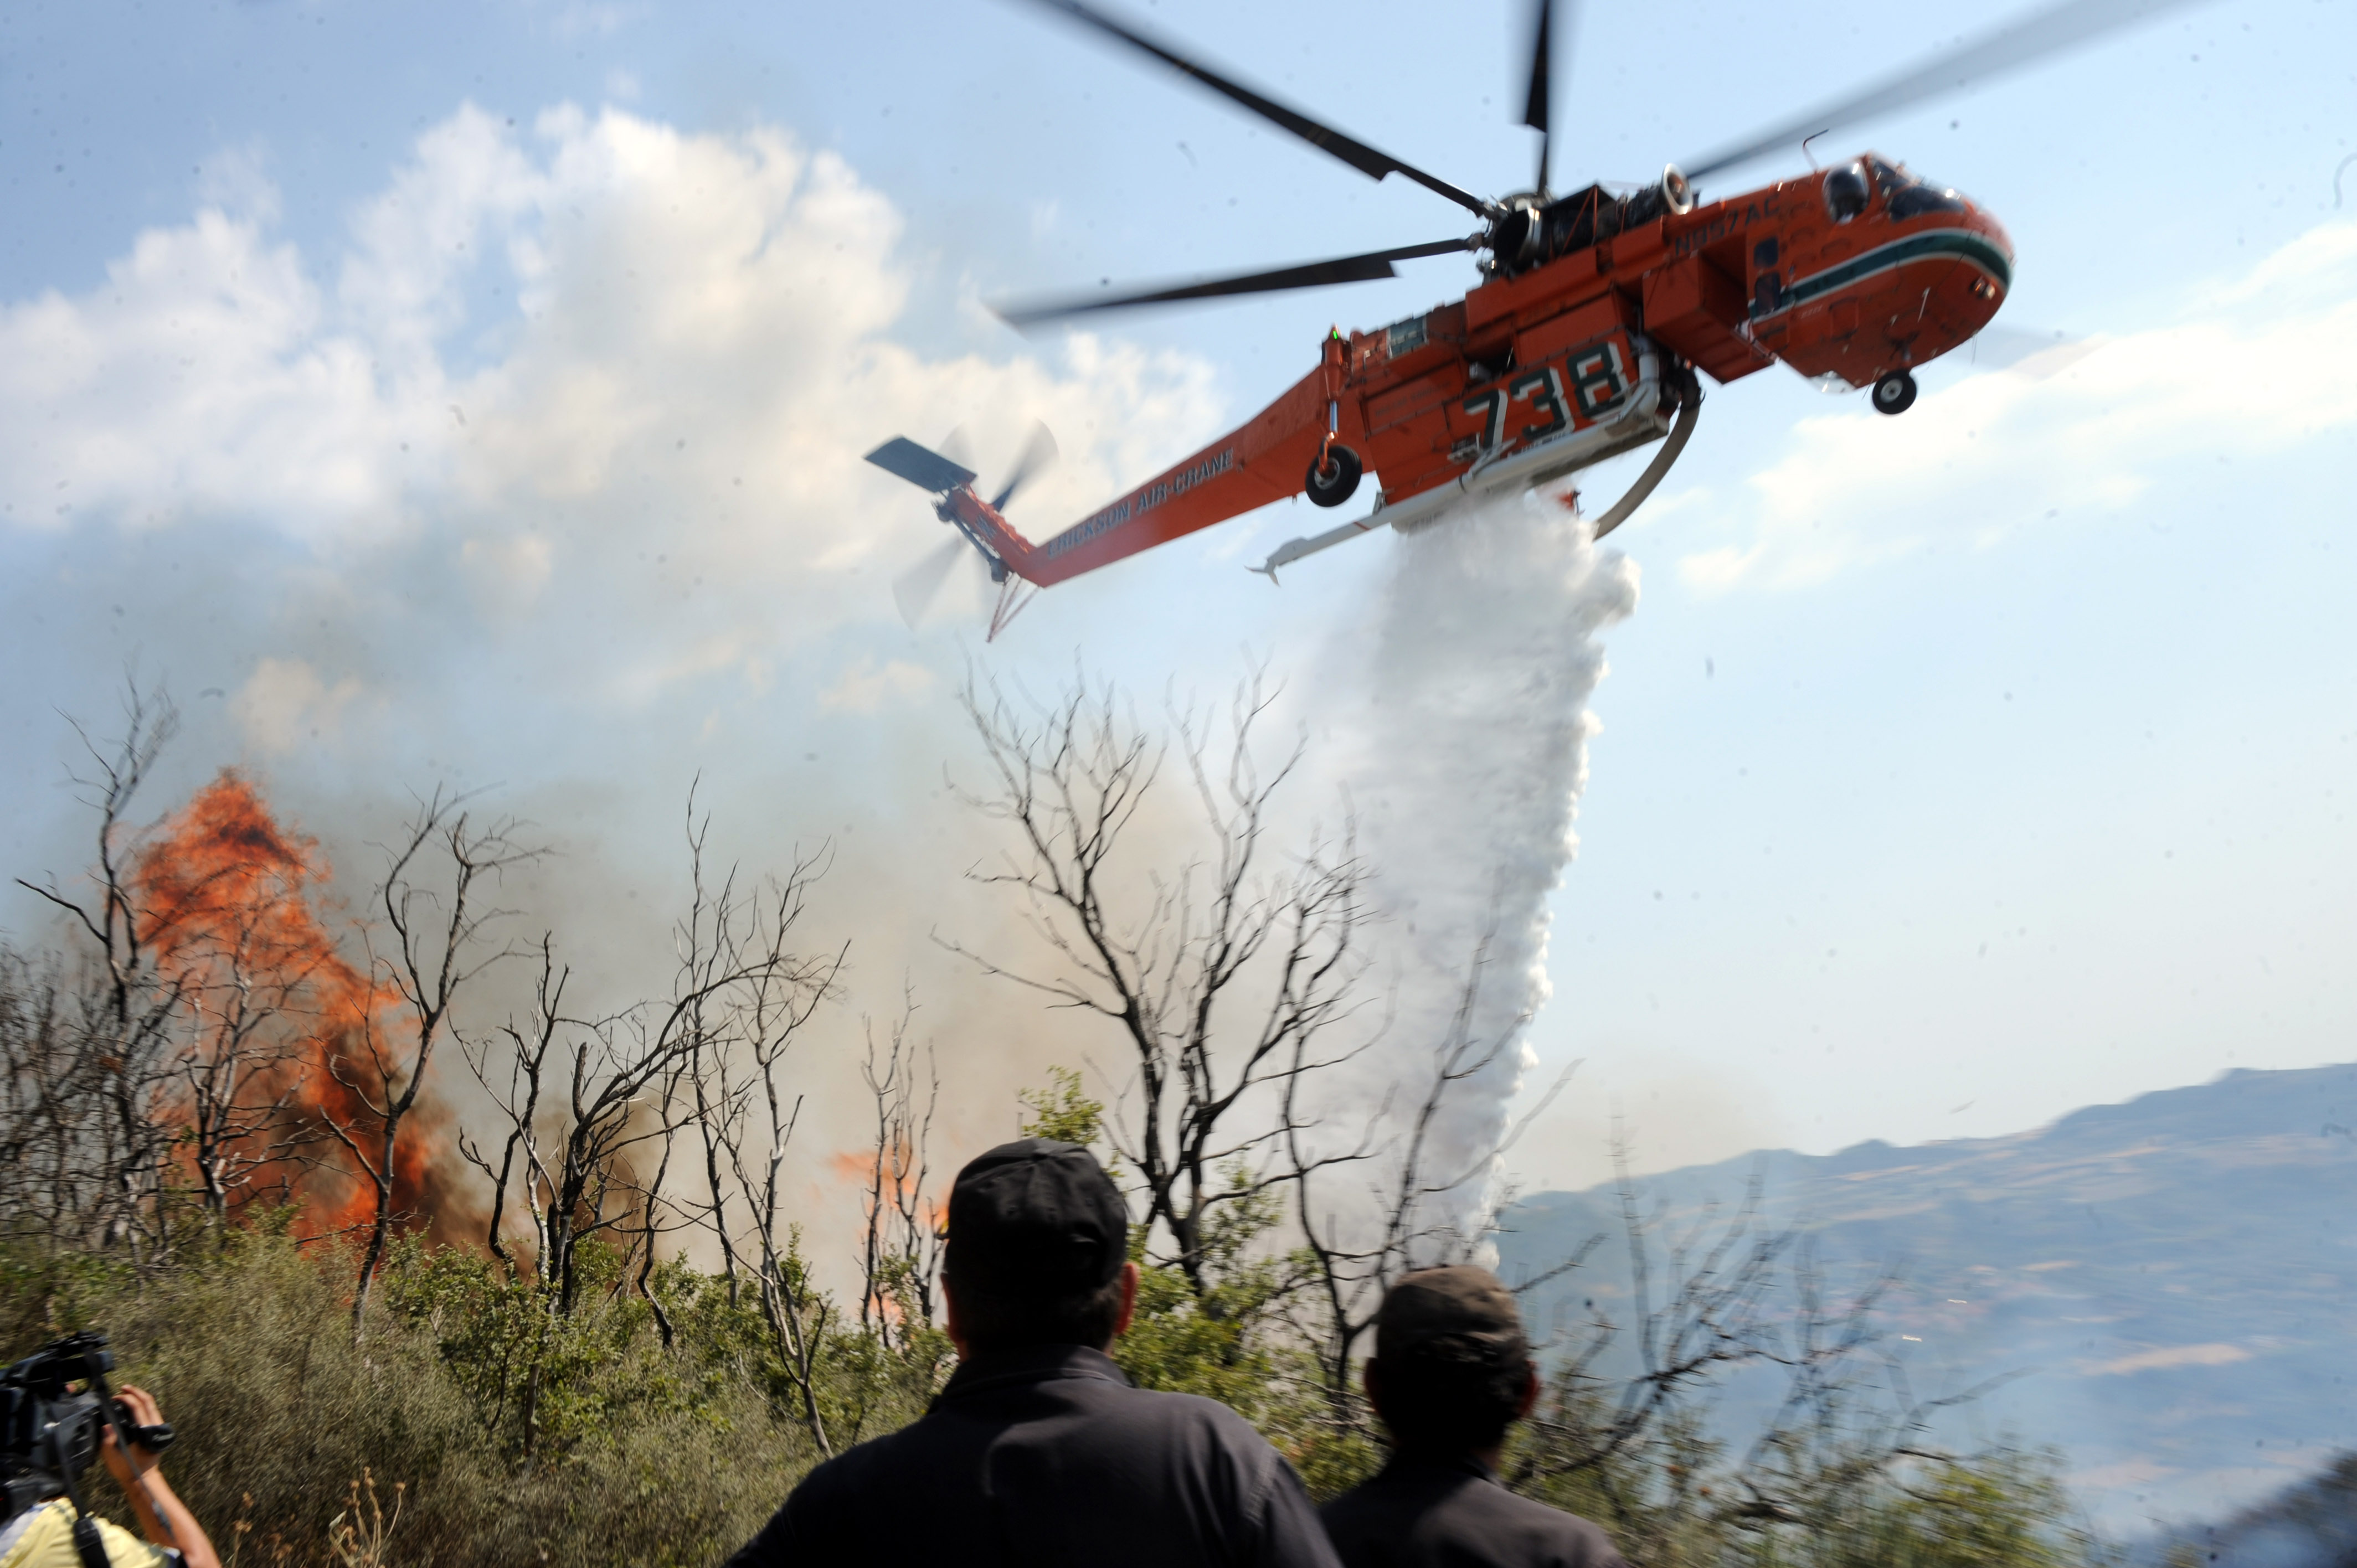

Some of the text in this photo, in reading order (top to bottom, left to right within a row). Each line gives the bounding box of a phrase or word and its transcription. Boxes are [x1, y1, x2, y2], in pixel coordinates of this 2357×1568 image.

[1463, 341, 1630, 451] 738
[1047, 500, 1131, 559] ERICKSON
[1136, 447, 1234, 510] AIR-CRANE
